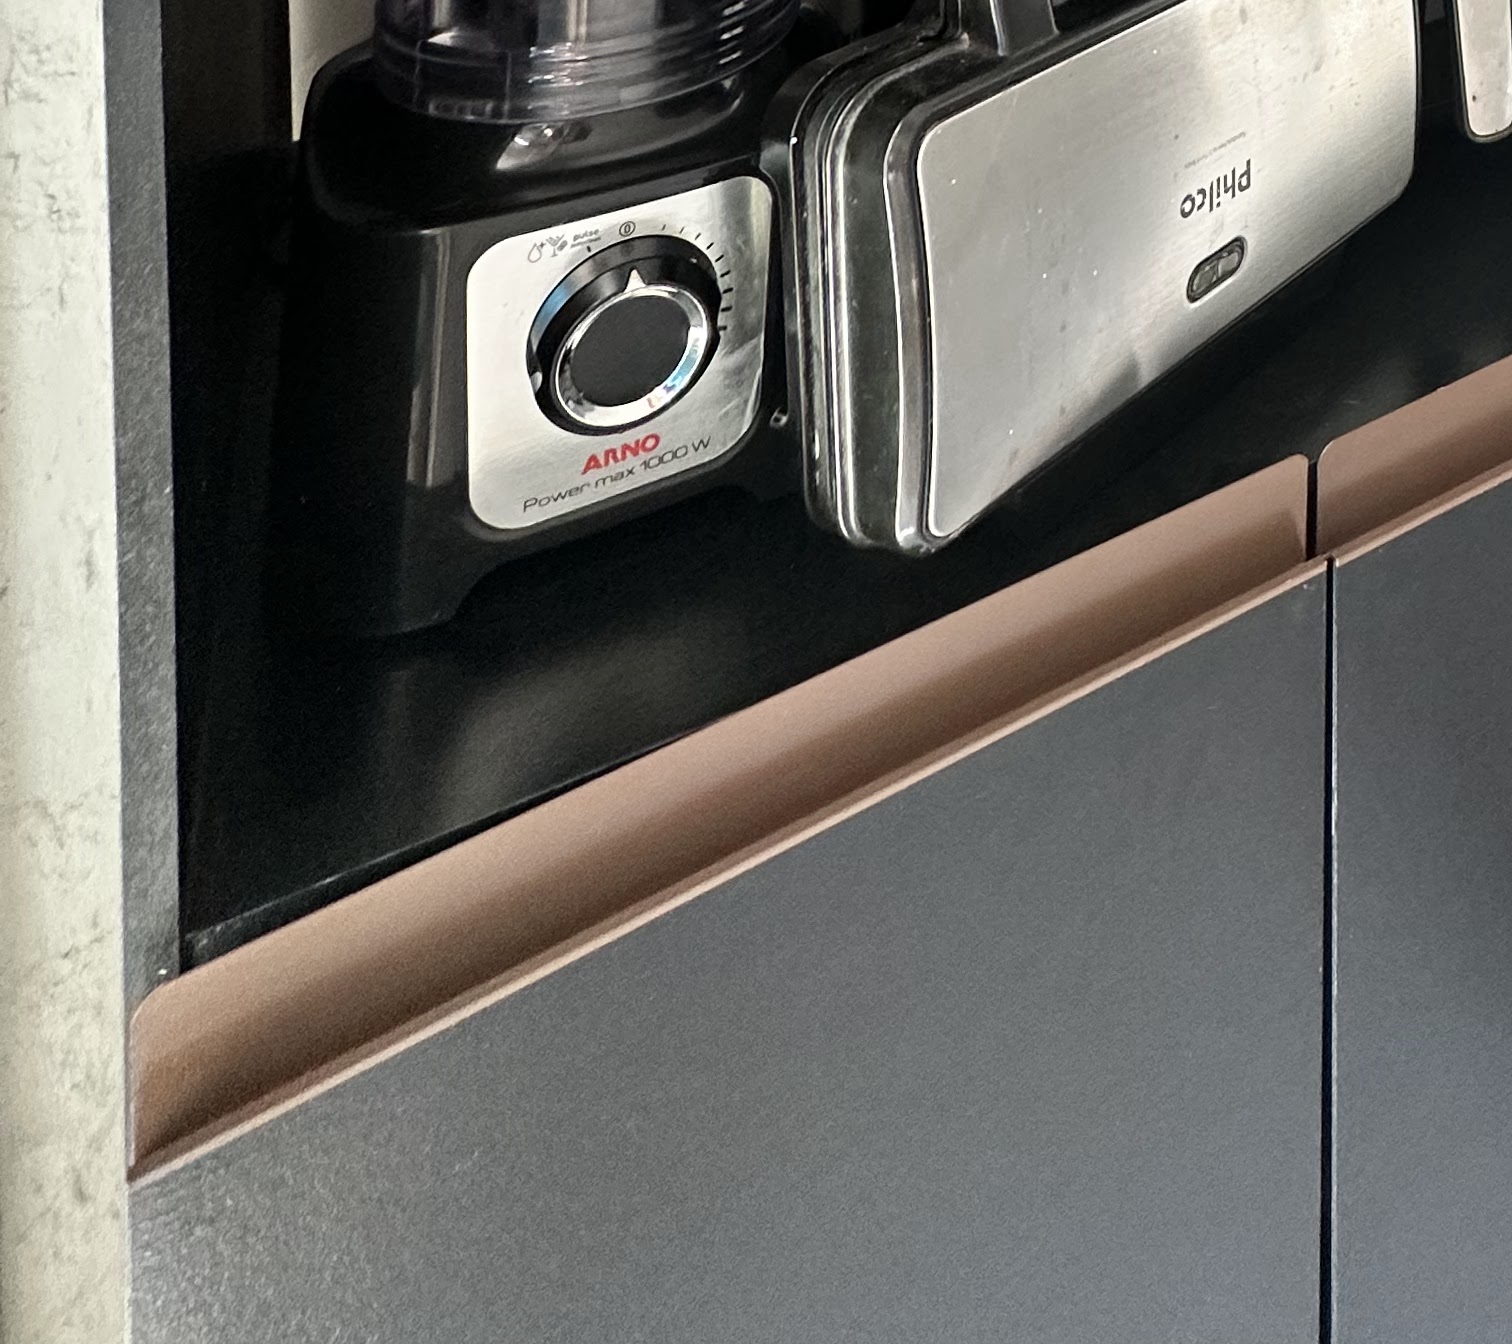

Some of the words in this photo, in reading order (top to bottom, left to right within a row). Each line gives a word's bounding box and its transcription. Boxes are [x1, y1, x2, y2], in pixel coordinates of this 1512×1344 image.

[1180, 158, 1251, 219] Philco
[572, 227, 600, 242] pulse
[523, 483, 591, 512] Power
[594, 465, 636, 490] max
[639, 446, 688, 473] 1000
[688, 435, 712, 458] W
[580, 433, 661, 475] ARNO
